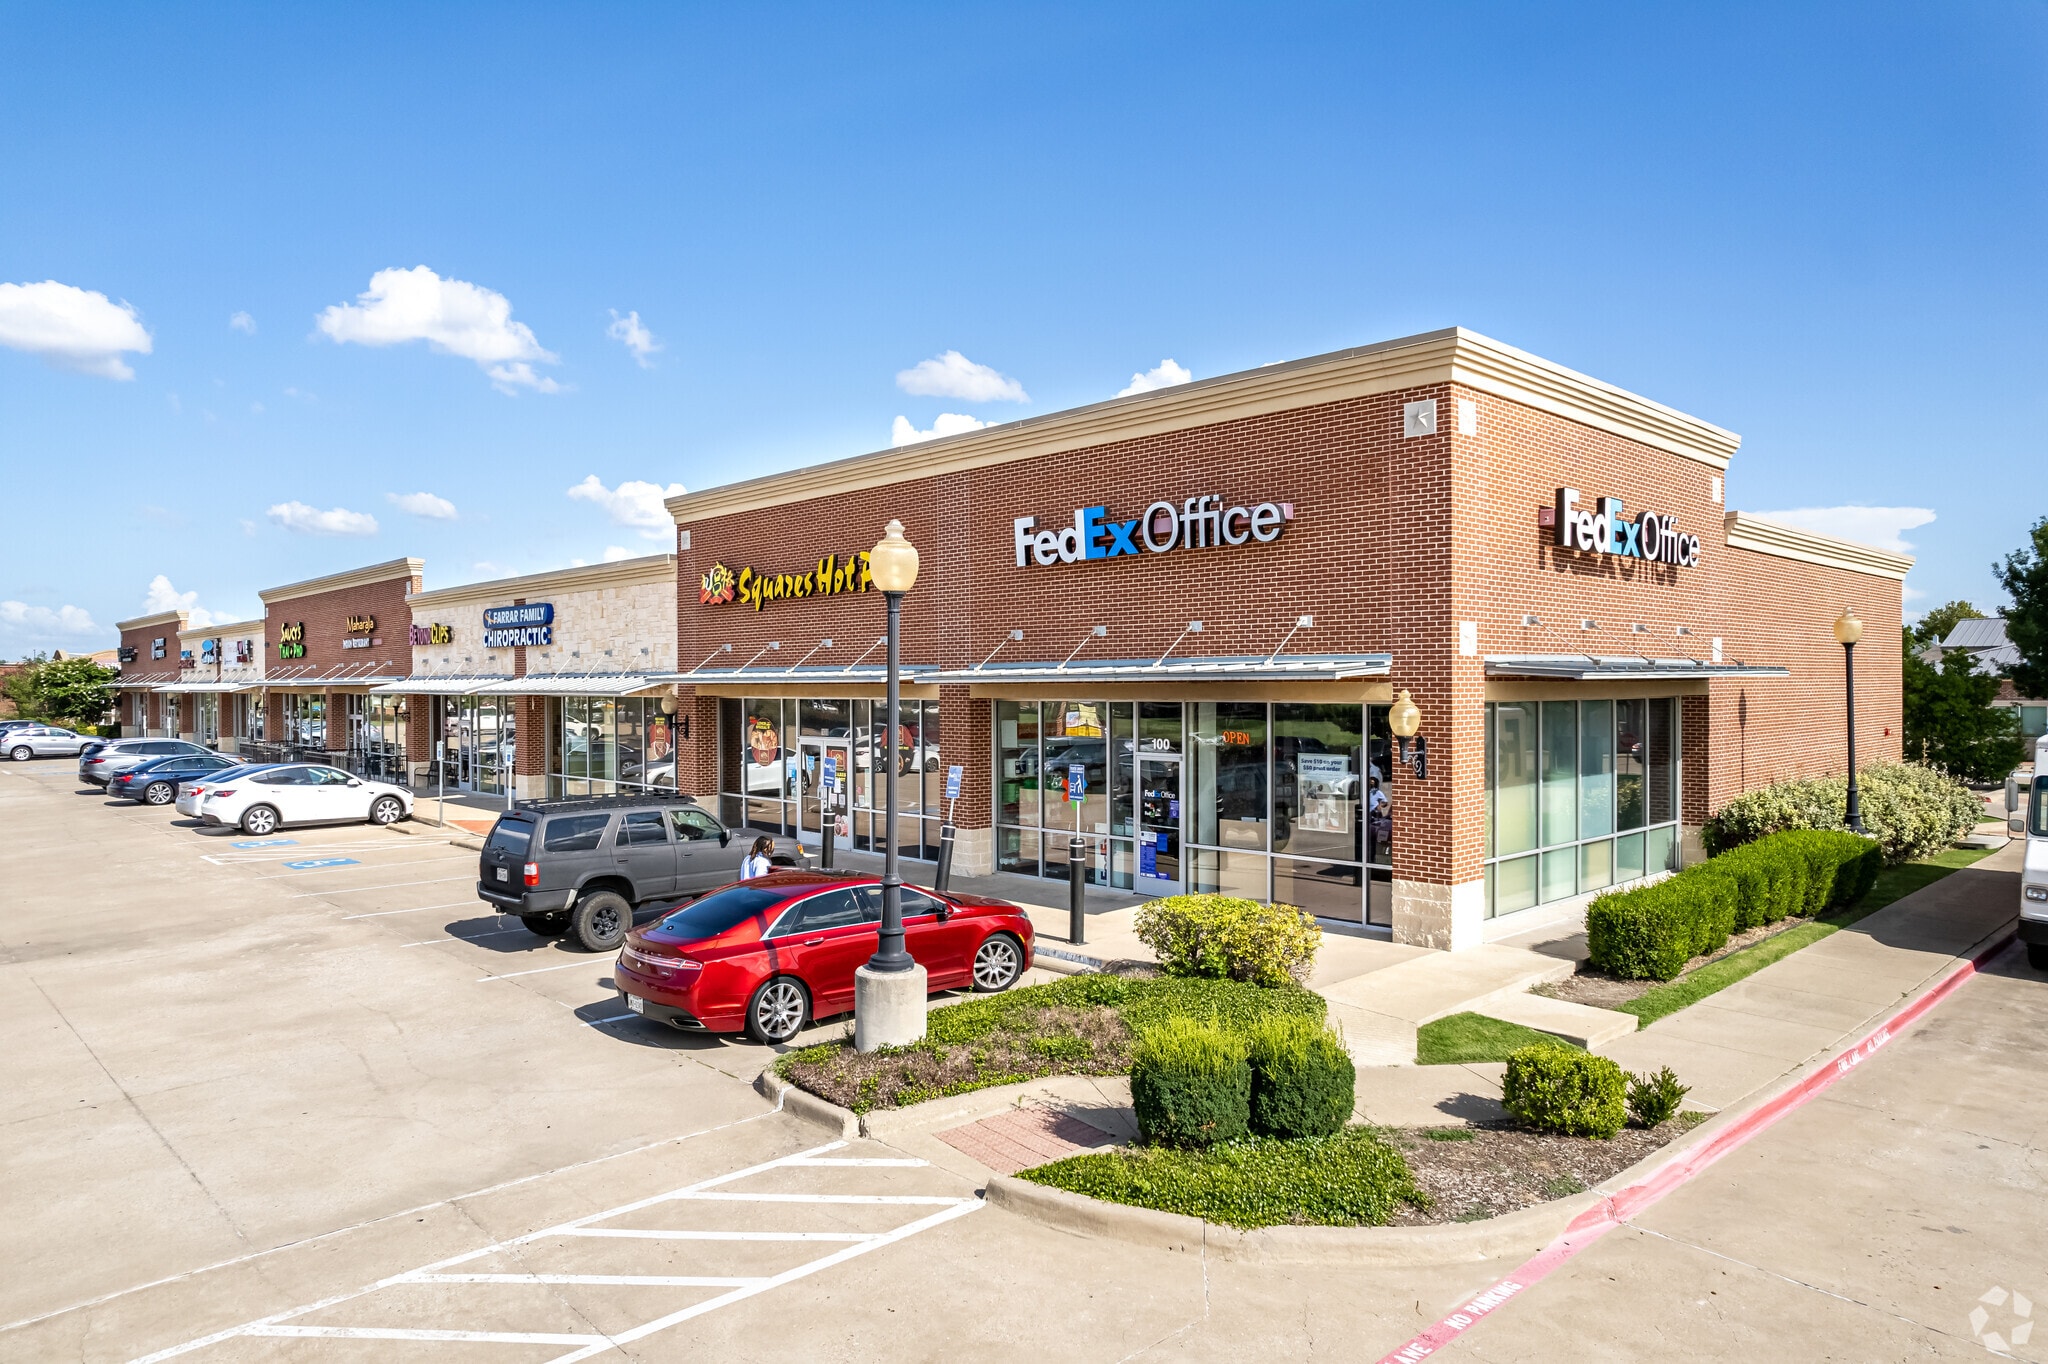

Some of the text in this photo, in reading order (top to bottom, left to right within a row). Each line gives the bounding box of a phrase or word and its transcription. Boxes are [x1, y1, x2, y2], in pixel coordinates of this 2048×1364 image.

[1014, 494, 1286, 567] FedEx Office
[1562, 487, 1701, 568] FedEx Office
[738, 566, 813, 612] Squares
[816, 553, 857, 596] Hot
[346, 615, 375, 634] Maharaja
[493, 607, 545, 624] FARRAR FAMILY
[482, 627, 548, 648] CHIROPRACTIC
[1152, 738, 1170, 750] 100
[1222, 730, 1250, 745] OPEN
[1385, 1280, 1524, 1364] ANE NO PARKING
